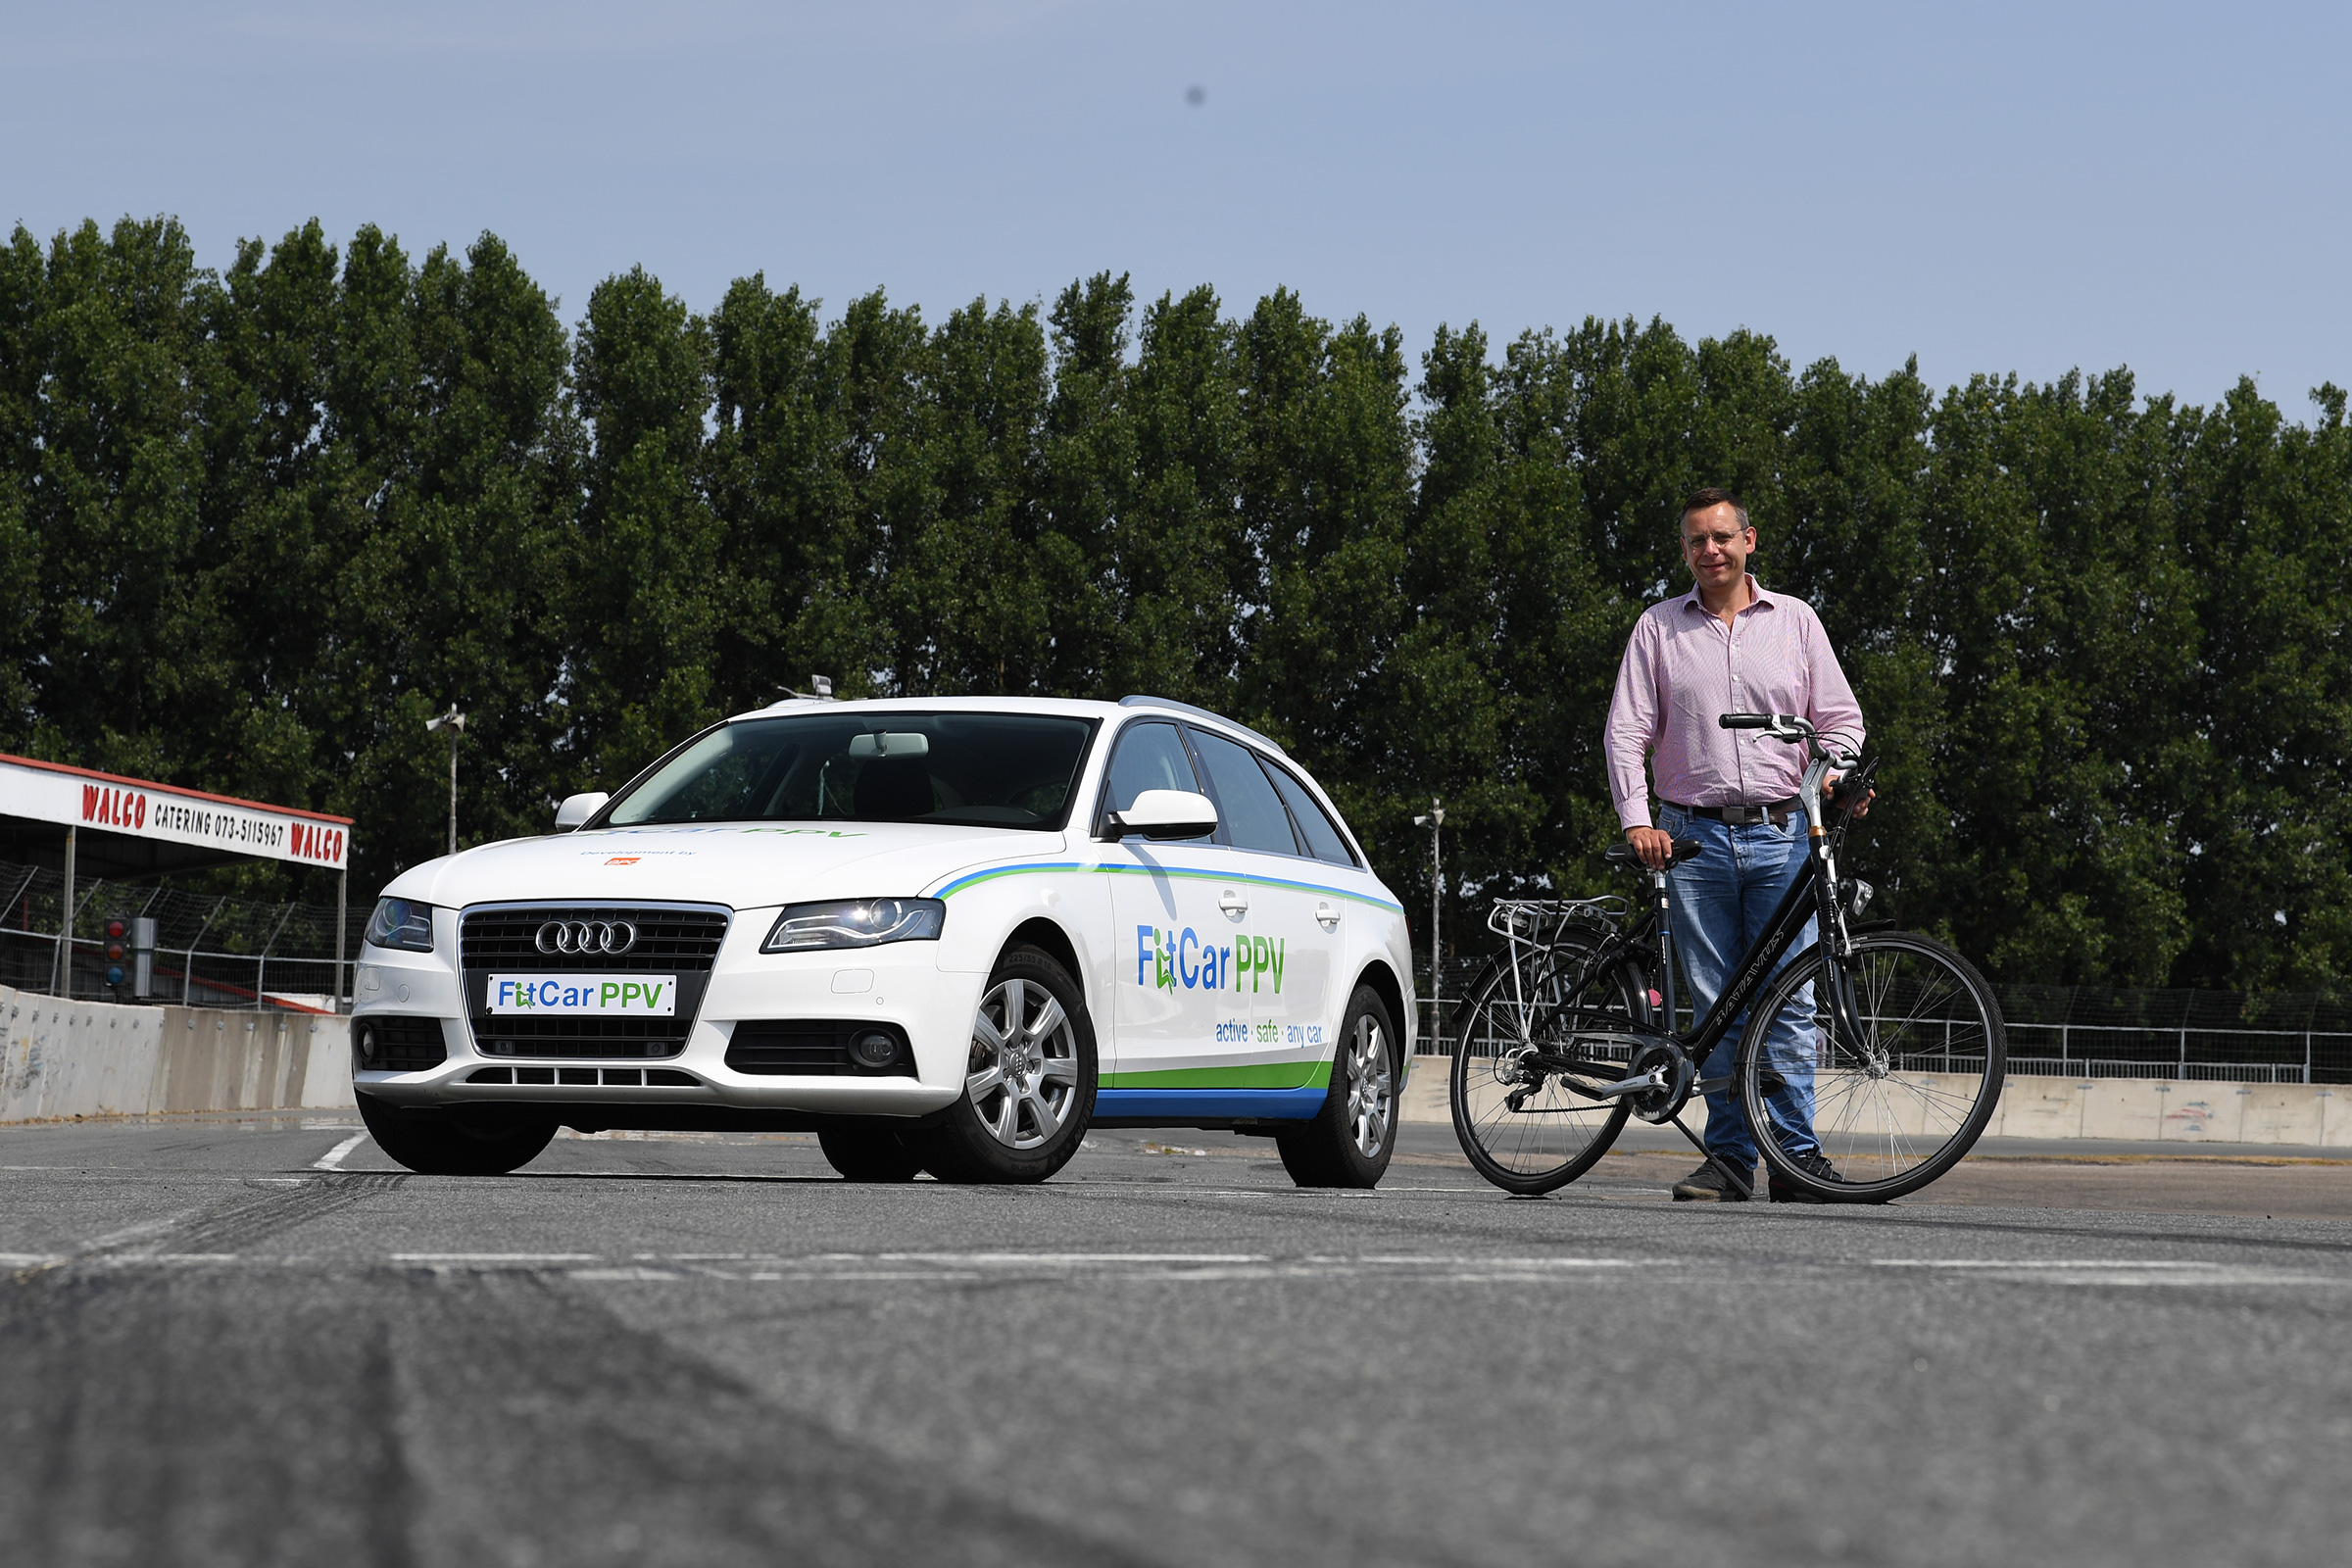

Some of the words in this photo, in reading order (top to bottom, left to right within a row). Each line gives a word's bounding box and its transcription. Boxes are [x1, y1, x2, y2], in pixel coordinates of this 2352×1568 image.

[82, 784, 146, 830] WALCO
[155, 804, 212, 835] CATERING
[215, 814, 283, 848] 073-5115967
[290, 821, 342, 863] WALCO
[739, 827, 869, 838] PPV
[1008, 954, 1036, 963] 225/55
[1137, 924, 1230, 995] FitCar
[1236, 934, 1285, 994] PPV
[1715, 928, 1784, 1026] BATAVUS
[498, 980, 594, 1009] FitCar
[600, 982, 662, 1008] PPV
[1216, 1018, 1248, 1043] active
[1256, 1019, 1279, 1043] safe
[1287, 1024, 1304, 1049] any
[1306, 1024, 1322, 1043] car
